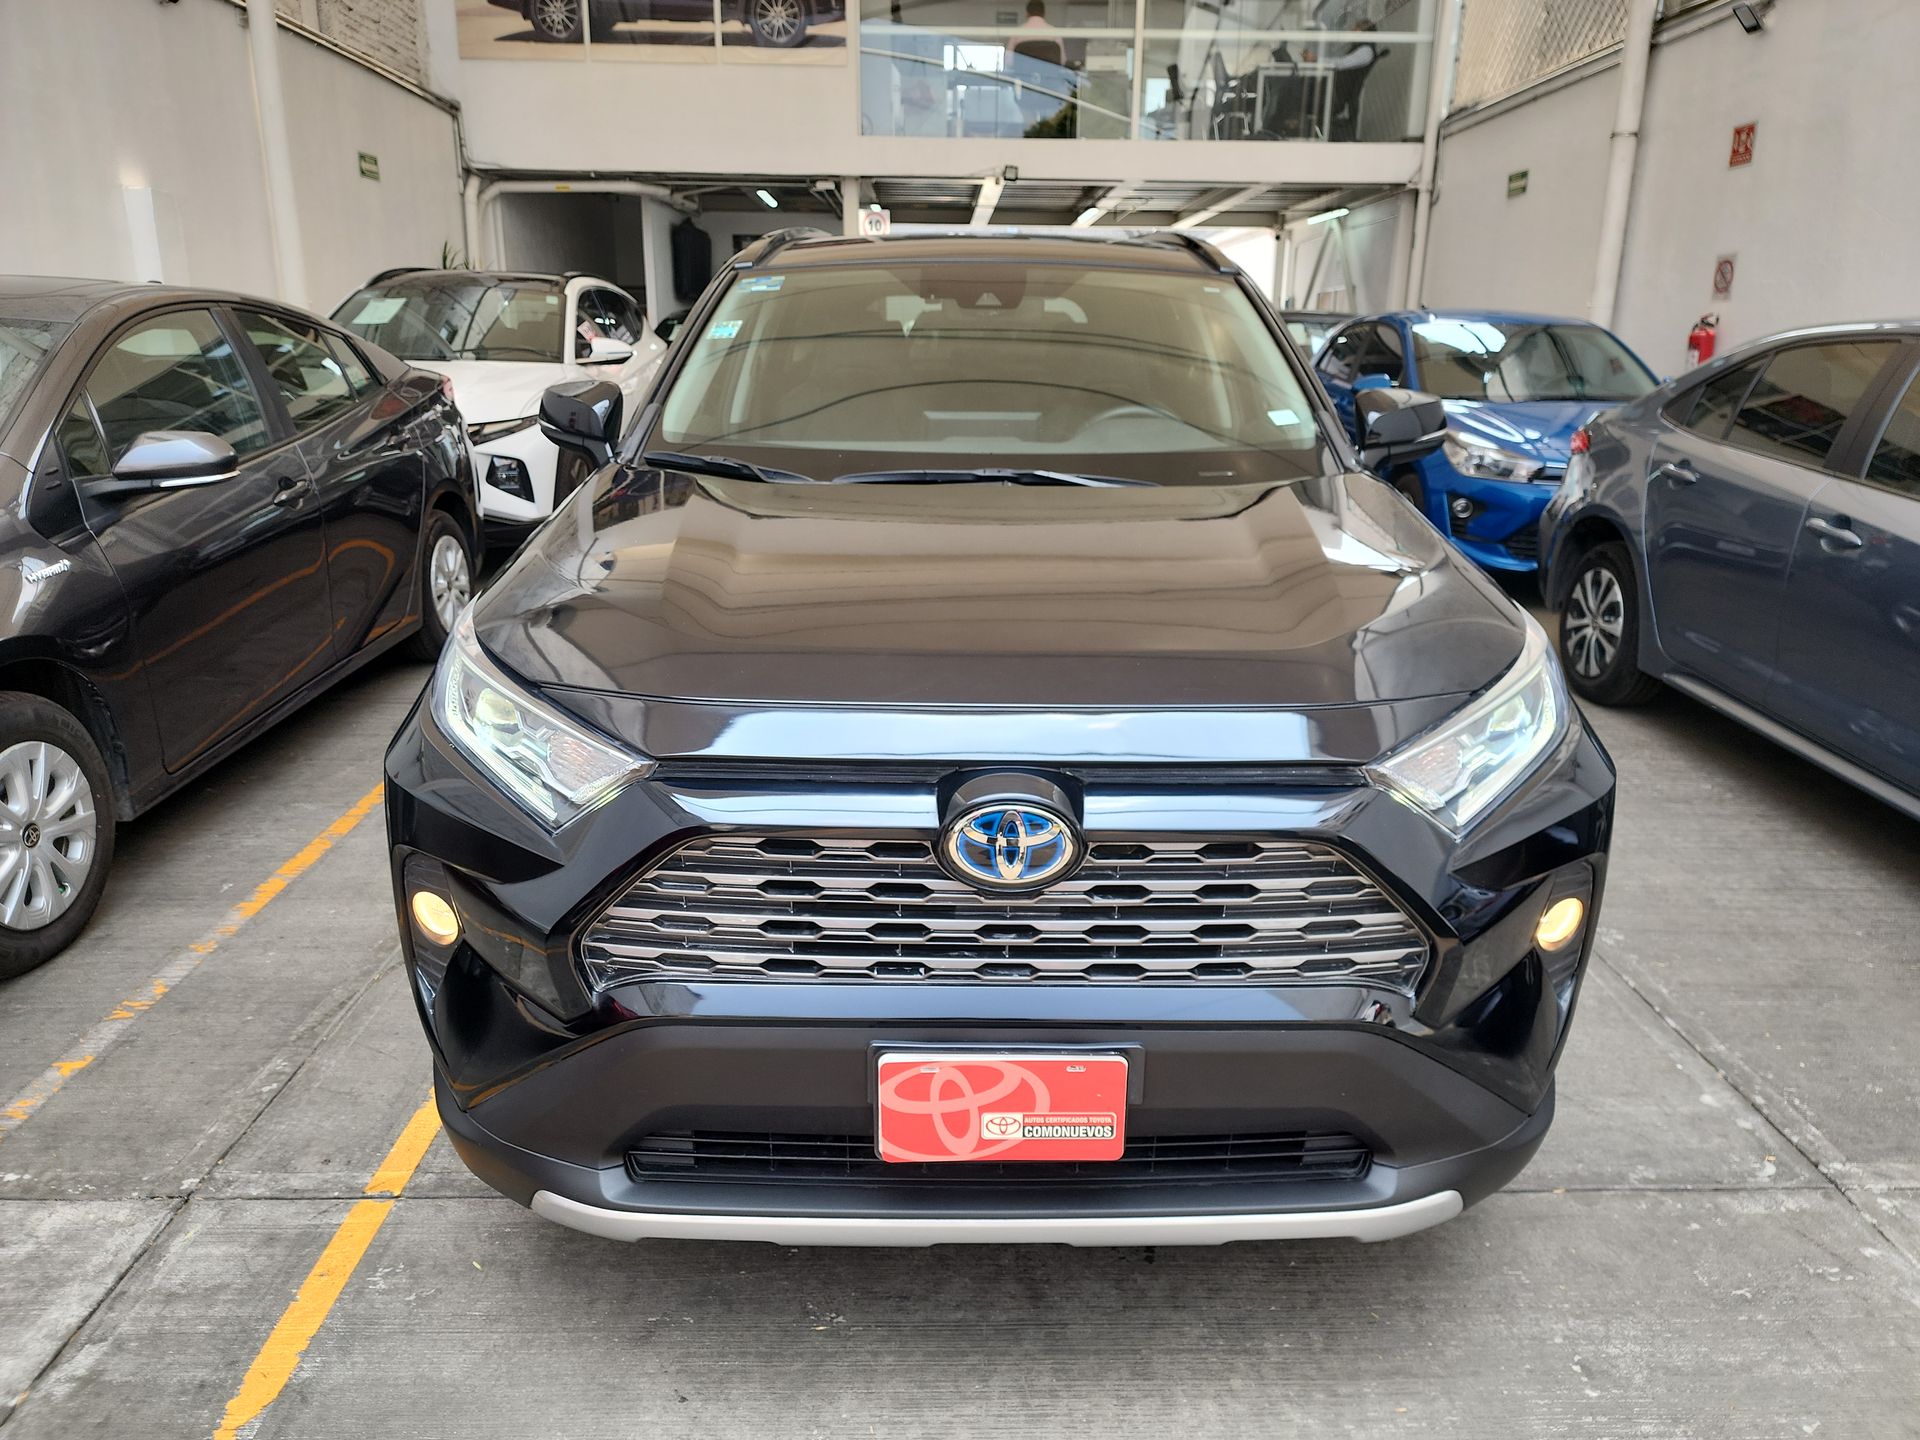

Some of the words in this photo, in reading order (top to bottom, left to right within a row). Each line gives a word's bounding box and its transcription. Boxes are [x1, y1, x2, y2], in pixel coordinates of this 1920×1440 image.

[868, 219, 882, 231] 10
[26, 561, 66, 584] HYBRID
[1024, 1126, 1112, 1137] COMONUEVOS
